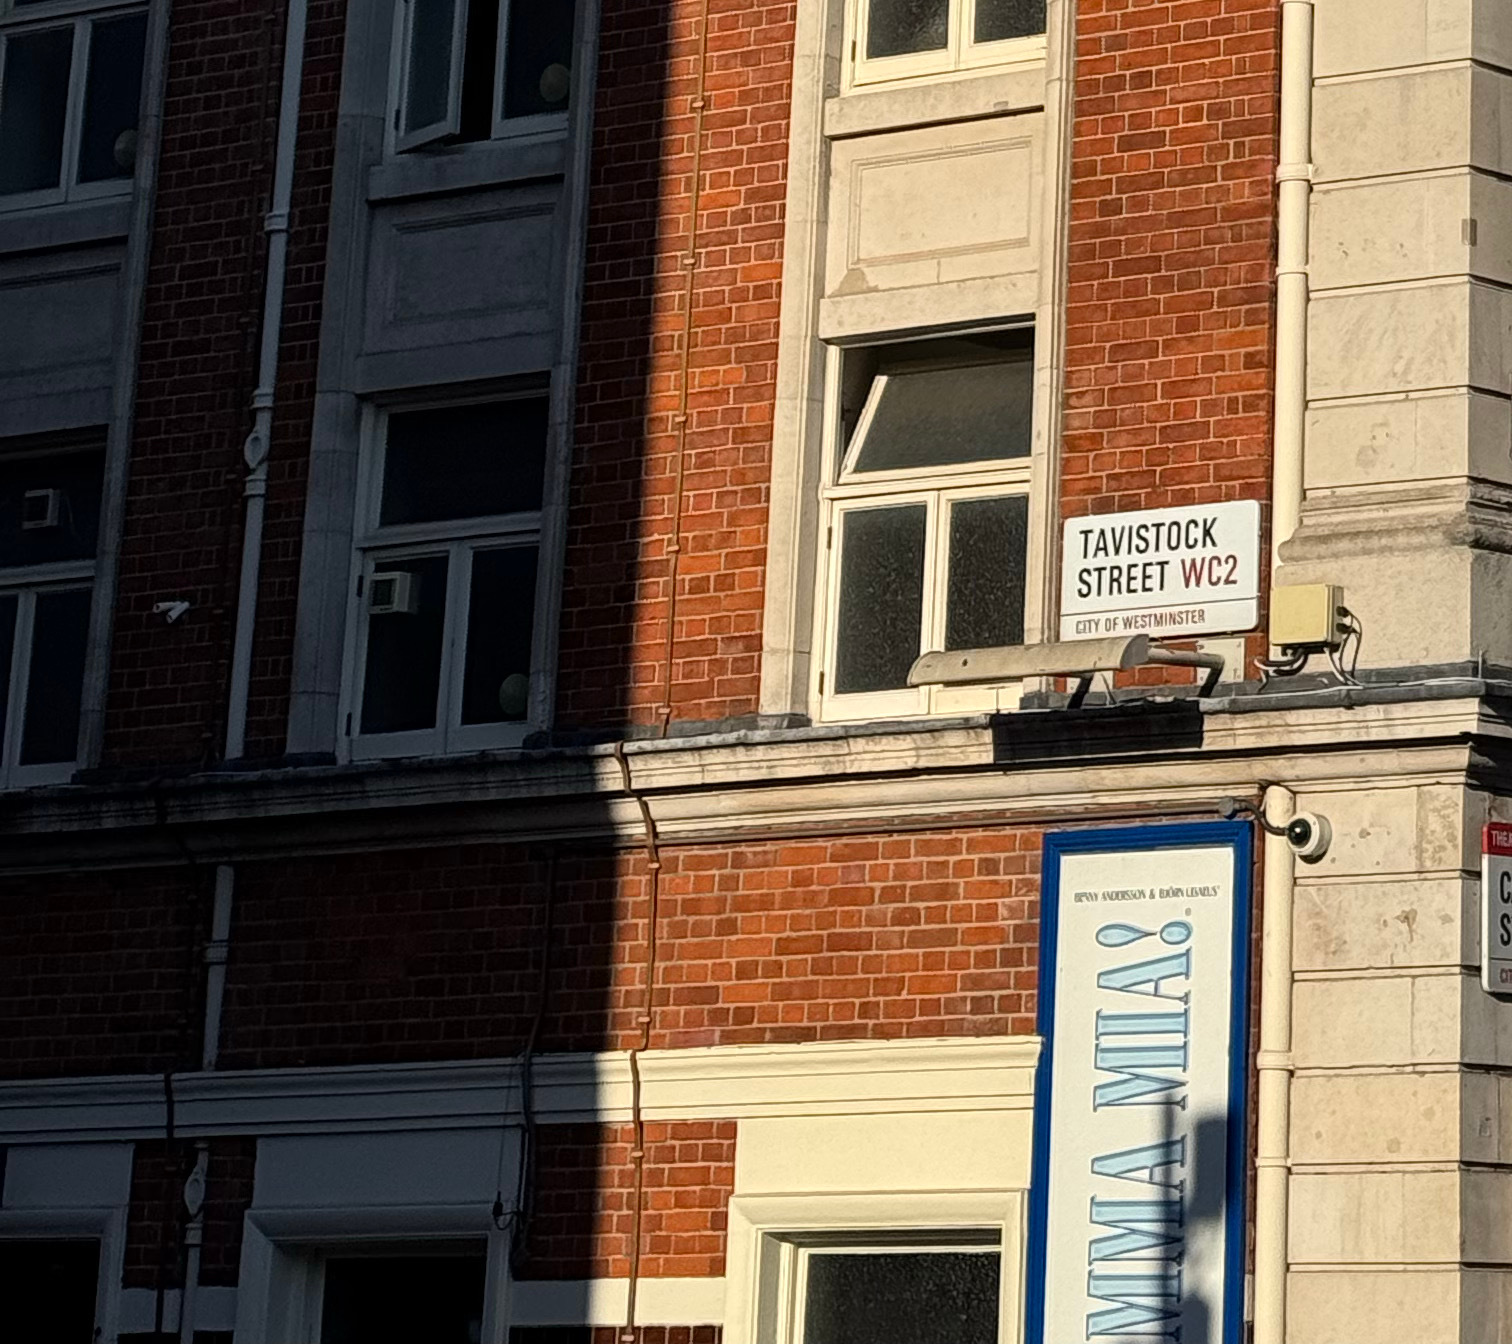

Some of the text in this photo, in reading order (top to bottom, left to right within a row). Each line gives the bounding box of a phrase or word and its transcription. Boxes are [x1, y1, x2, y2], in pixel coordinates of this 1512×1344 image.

[1079, 517, 1218, 560] TAVISTOCK
[1077, 554, 1238, 598] STREET WC2
[1075, 609, 1206, 635] CITY OF WESTMINSTER
[1086, 920, 1193, 1344] MMA MIA!
